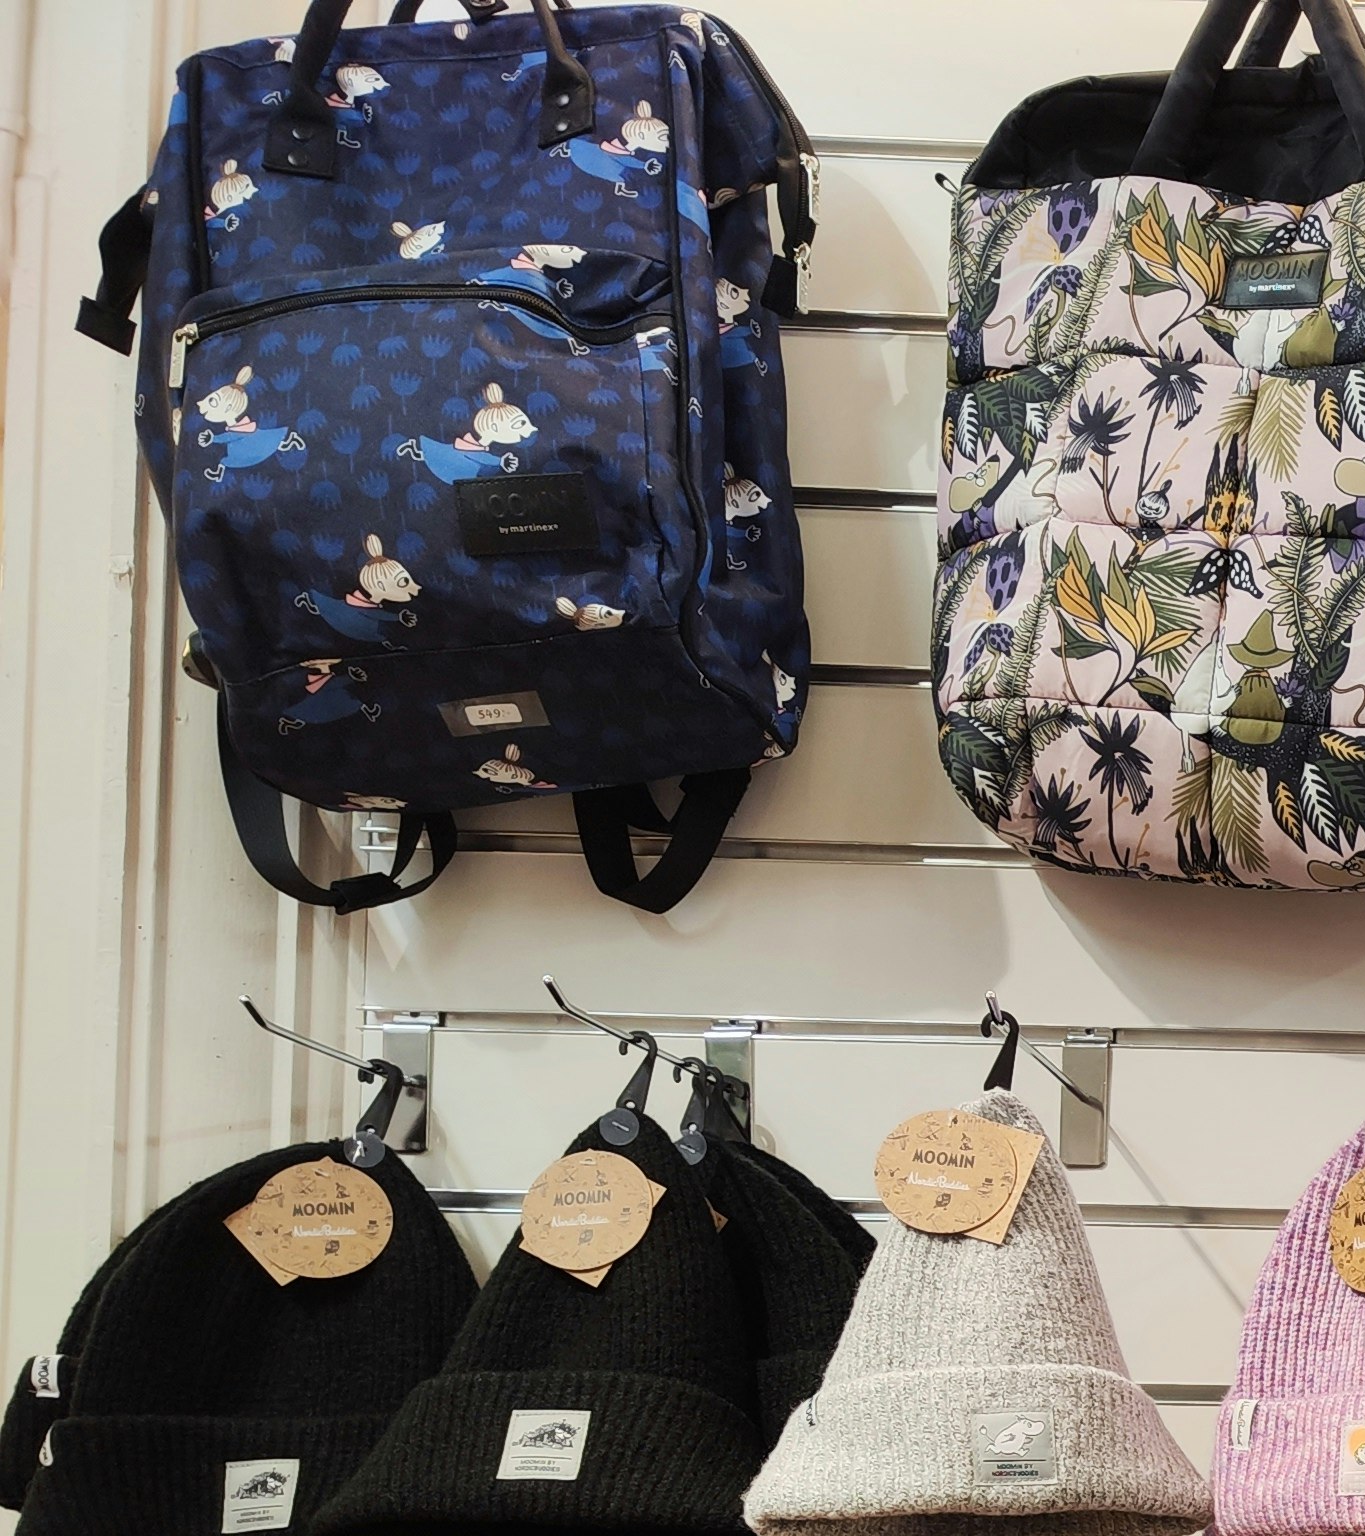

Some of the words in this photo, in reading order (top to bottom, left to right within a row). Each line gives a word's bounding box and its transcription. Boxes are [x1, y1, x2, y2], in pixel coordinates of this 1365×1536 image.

[1236, 259, 1315, 281] MOOMIN
[912, 1148, 976, 1168] MOOMIN
[553, 1189, 611, 1206] MOOMIN
[292, 1202, 355, 1217] MOOMIN
